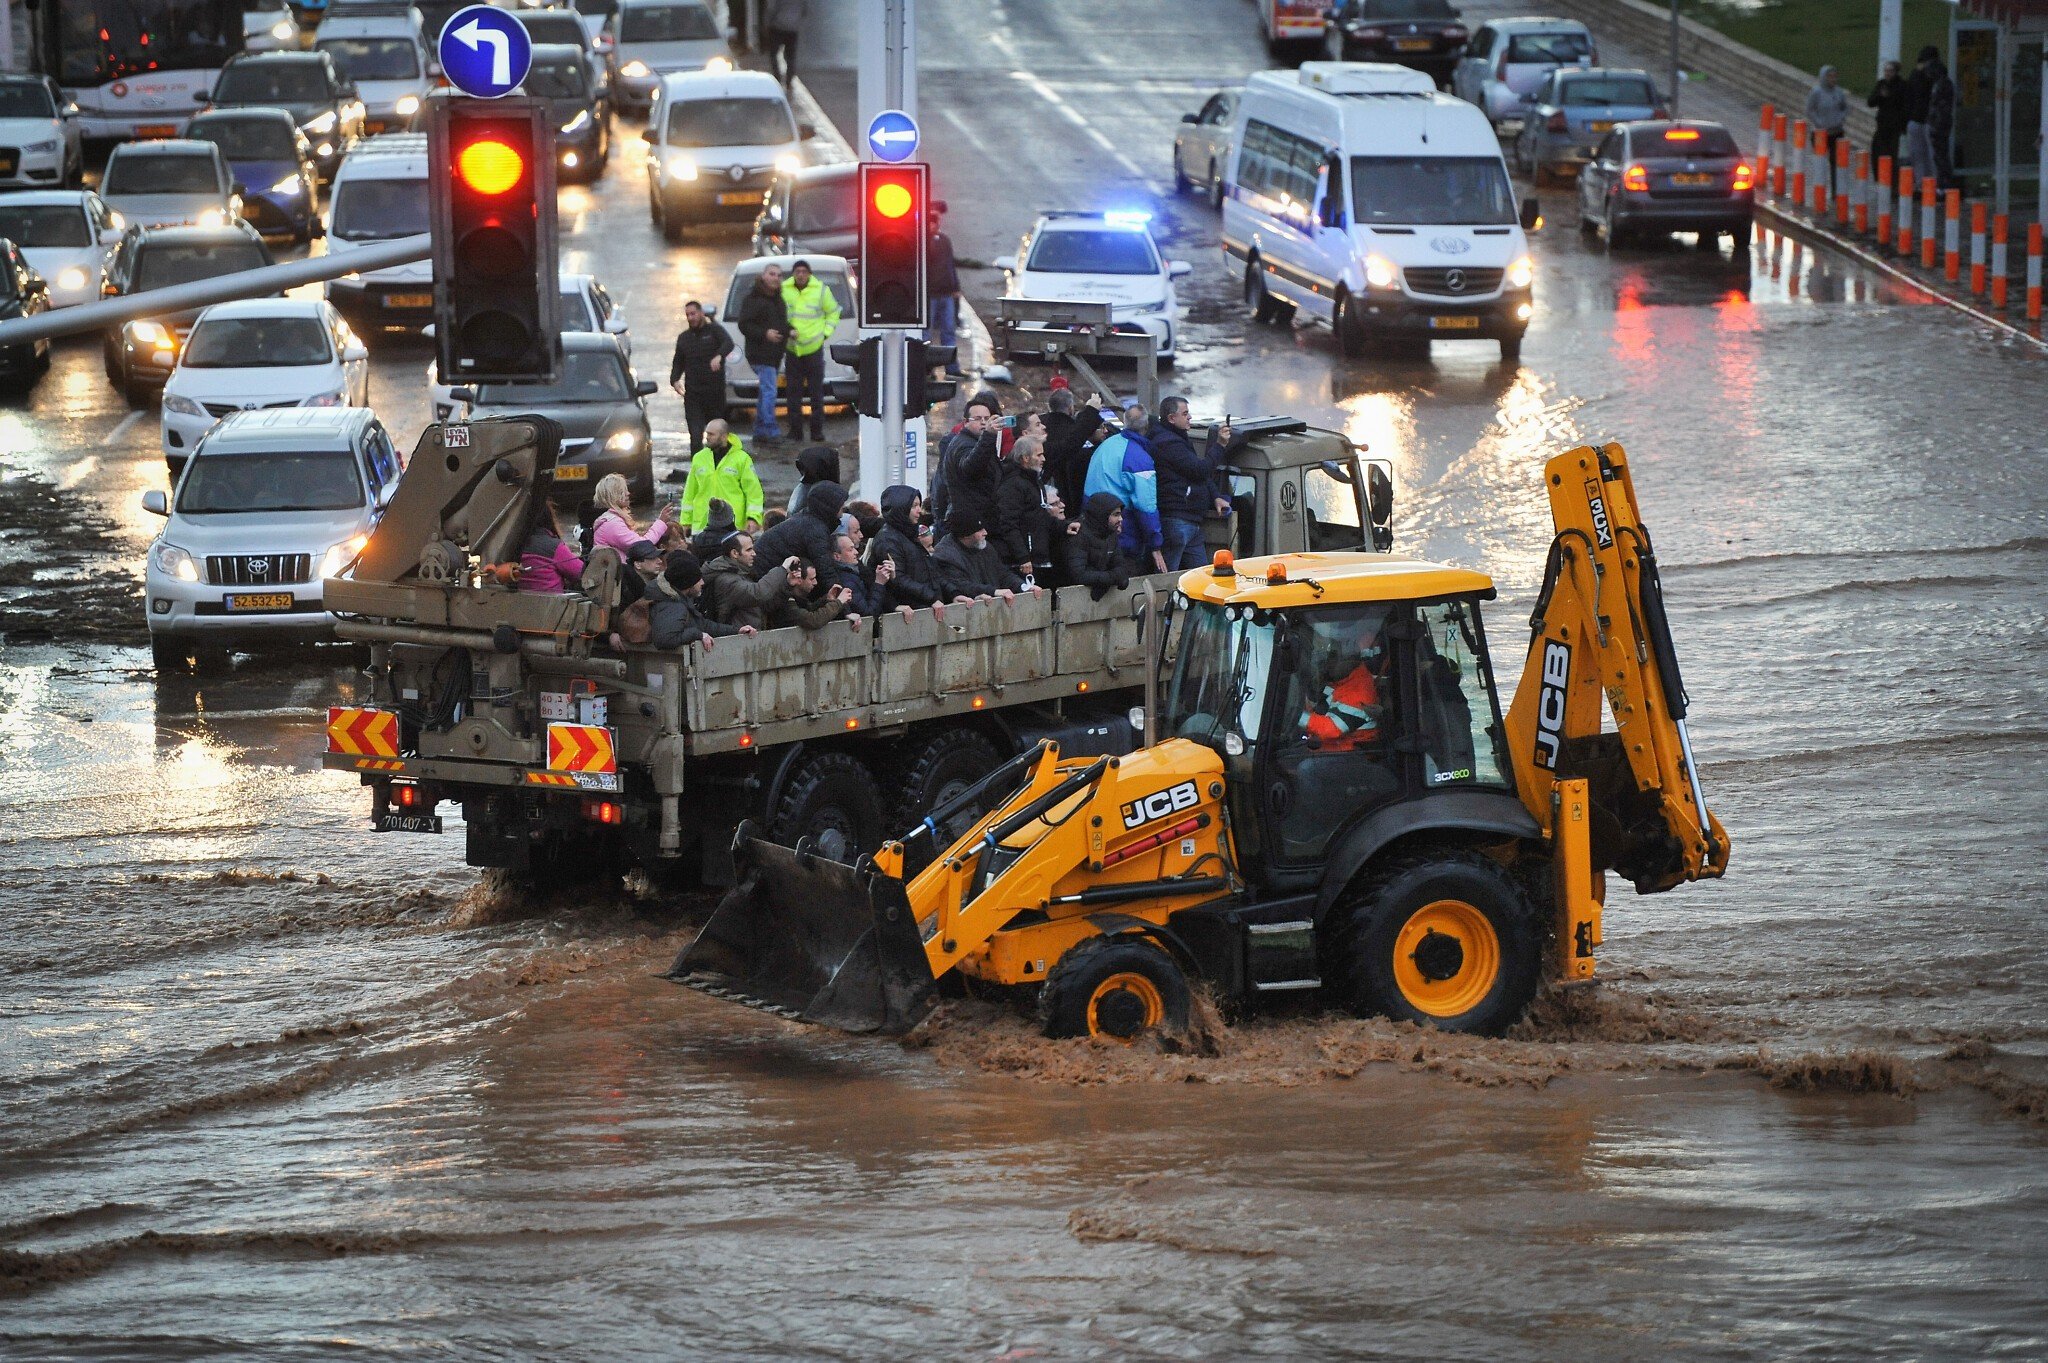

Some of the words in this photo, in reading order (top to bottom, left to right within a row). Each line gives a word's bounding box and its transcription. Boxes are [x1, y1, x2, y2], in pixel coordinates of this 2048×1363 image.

[1590, 498, 1611, 543] 3CX
[1538, 643, 1569, 768] JCB
[1124, 782, 1198, 827] JCB
